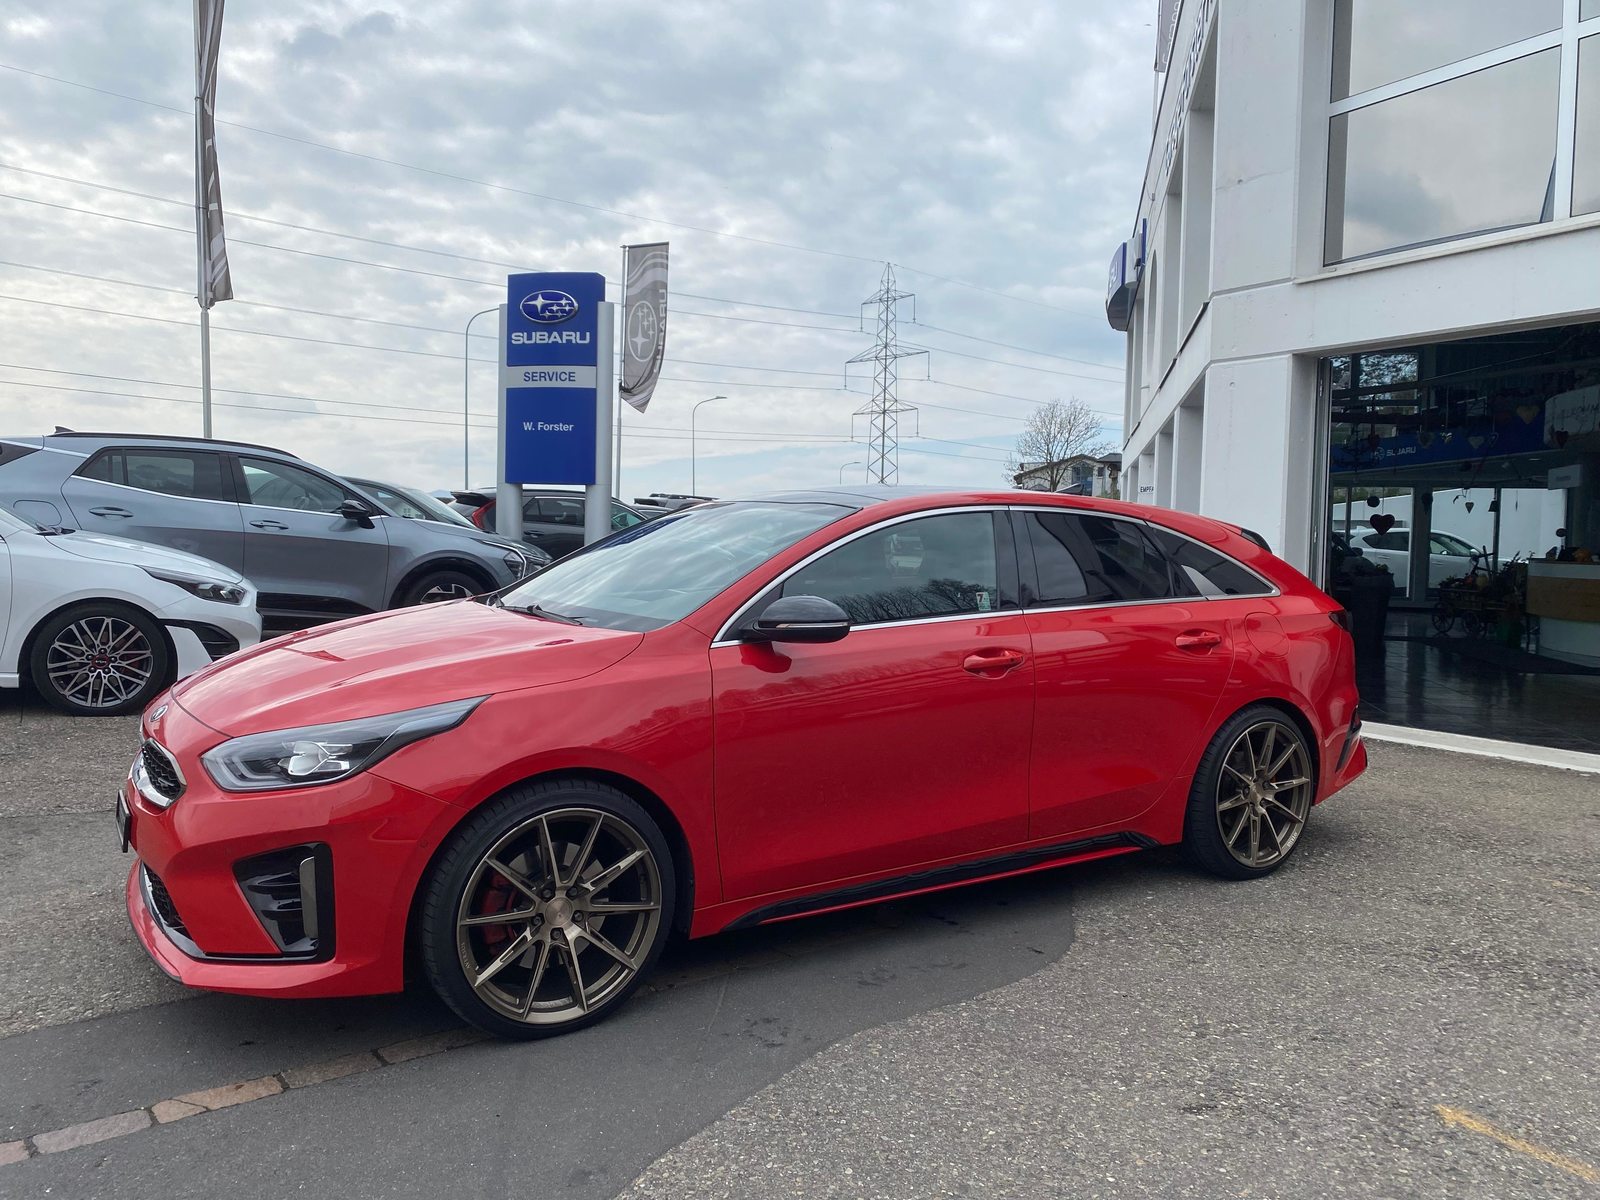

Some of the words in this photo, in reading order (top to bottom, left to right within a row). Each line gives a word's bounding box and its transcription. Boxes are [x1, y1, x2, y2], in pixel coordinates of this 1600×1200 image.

[511, 331, 591, 344] SUBARU
[523, 371, 576, 382] SERVICE
[523, 421, 535, 431] W.
[537, 421, 575, 431] Forster
